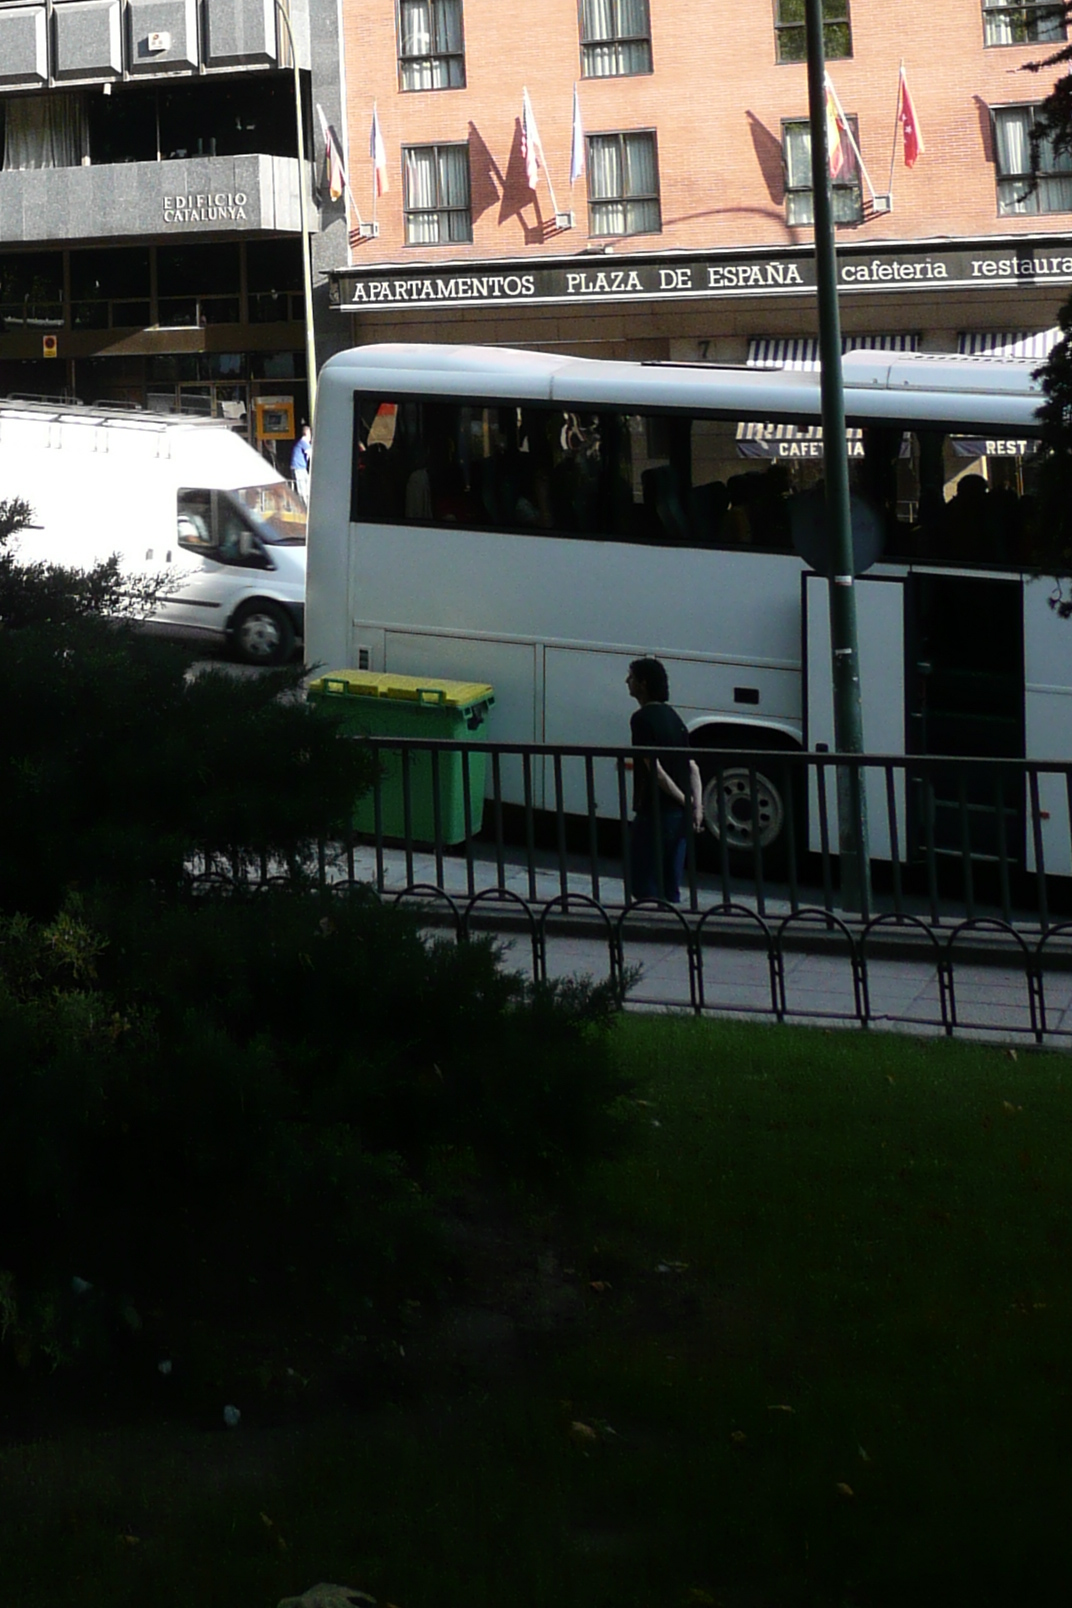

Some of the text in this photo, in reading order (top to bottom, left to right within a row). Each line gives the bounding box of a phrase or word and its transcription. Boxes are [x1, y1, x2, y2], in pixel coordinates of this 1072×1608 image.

[163, 192, 247, 209] EDIFICIO
[163, 207, 247, 223] CATALUNYA
[352, 275, 535, 302] APARTAMENTOS
[566, 271, 644, 293] PLAZA
[659, 268, 692, 290] DE
[708, 261, 804, 288] ESPAÑA
[841, 258, 948, 281] cafeteria
[697, 339, 711, 359] 7
[779, 441, 865, 456] CAFEIA
